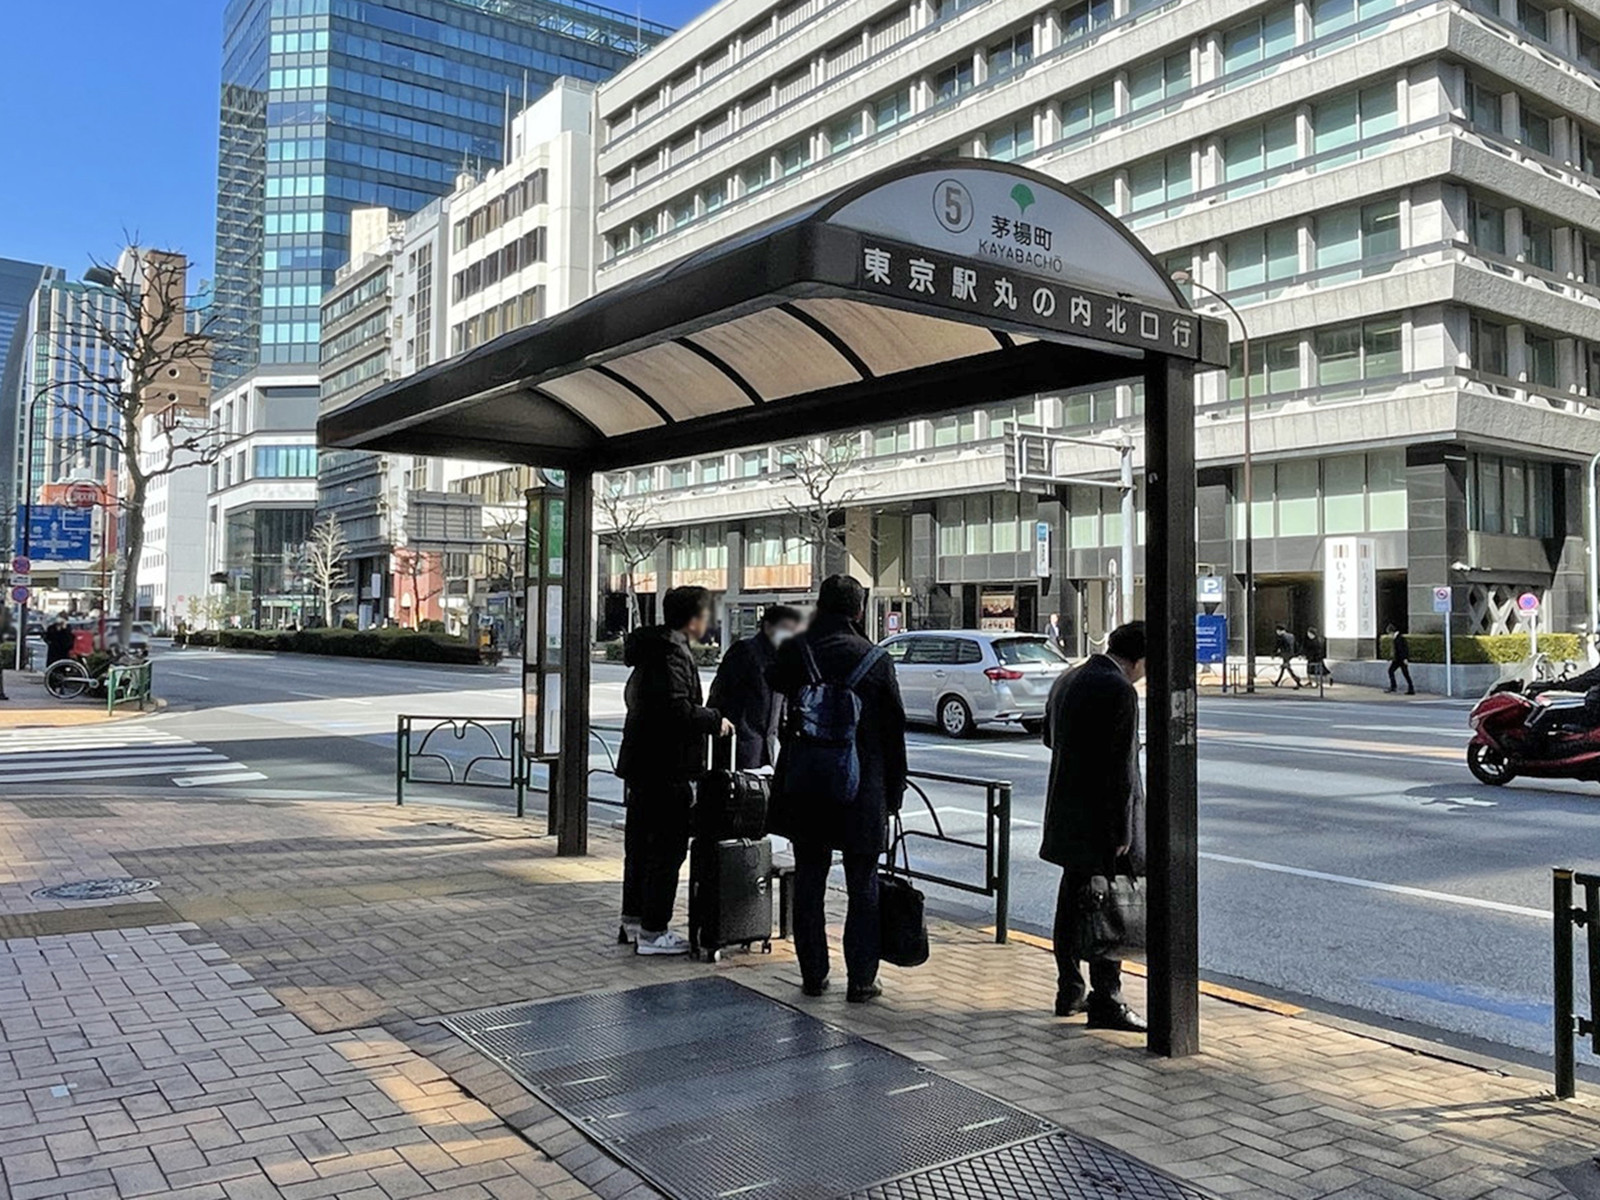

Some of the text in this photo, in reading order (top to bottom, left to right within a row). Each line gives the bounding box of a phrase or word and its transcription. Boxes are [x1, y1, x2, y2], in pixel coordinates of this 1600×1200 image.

[945, 186, 962, 226] 5
[991, 214, 1052, 252] 茅場町
[863, 247, 1192, 349] 東京駅丸の内北口行
